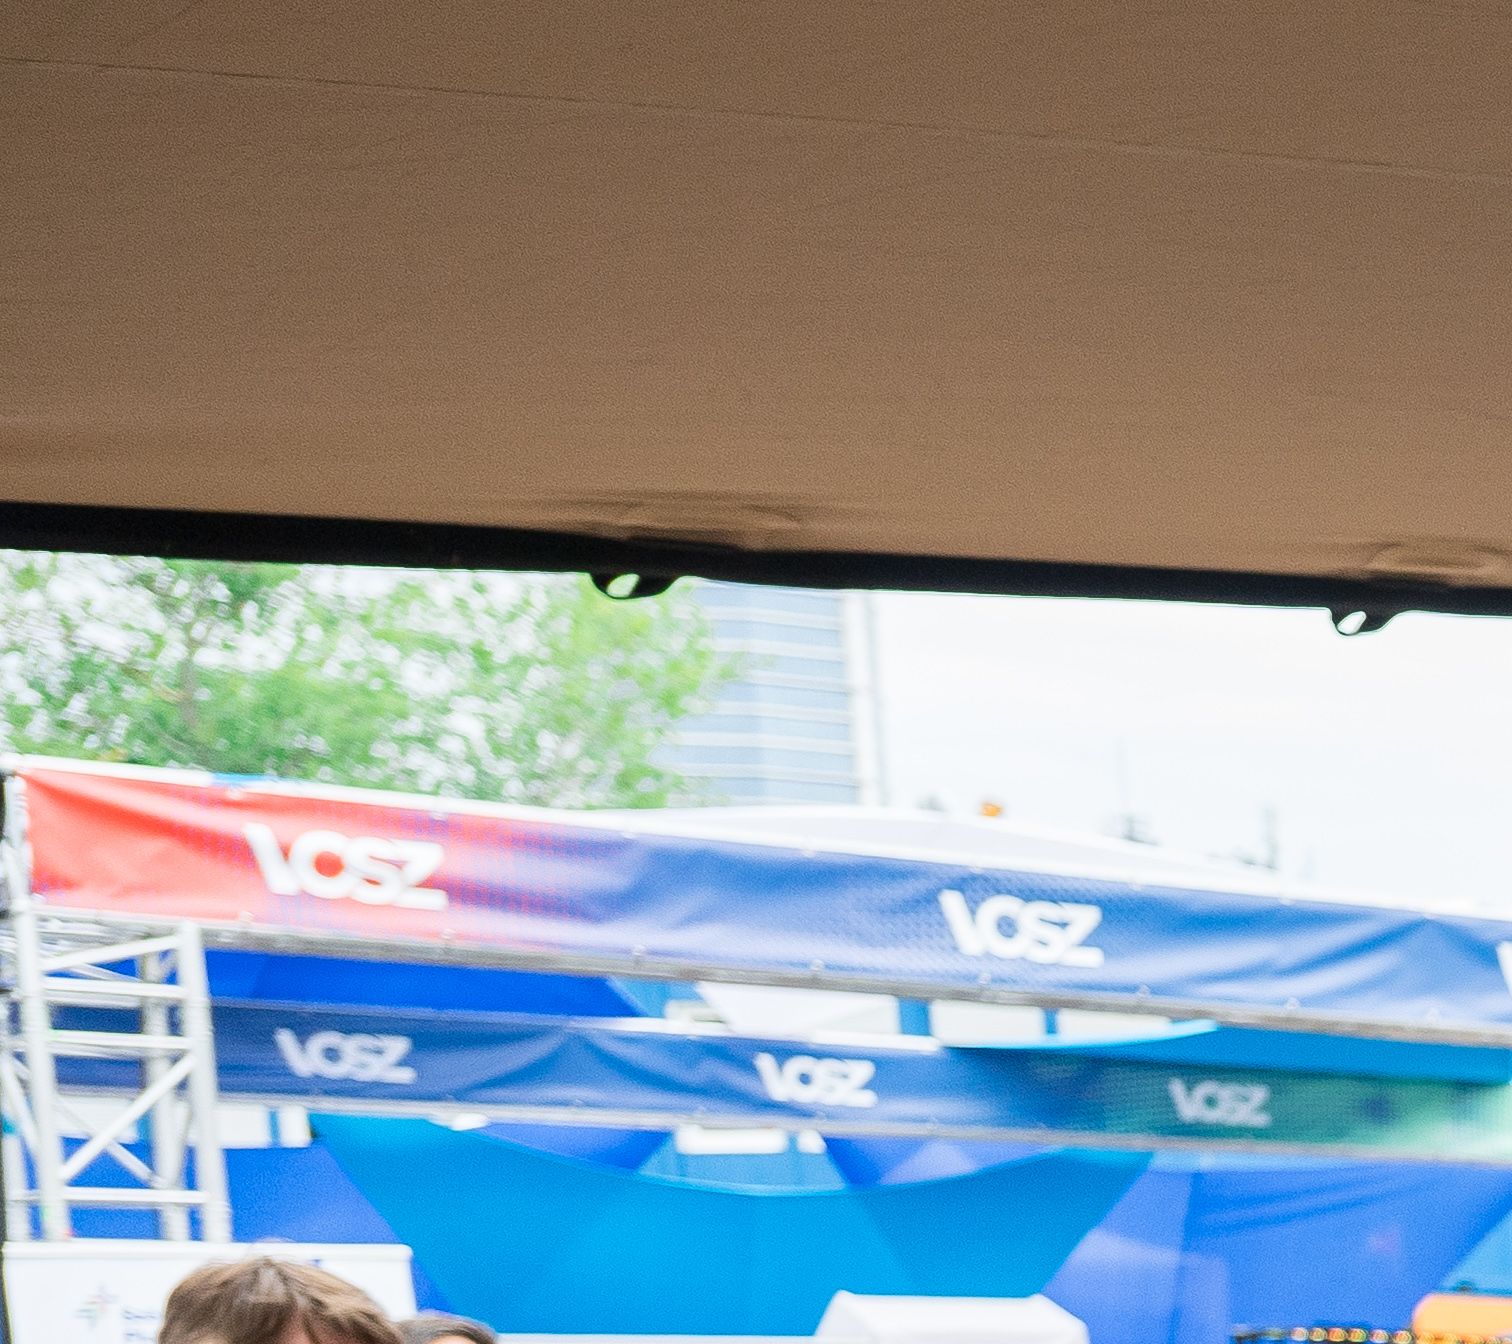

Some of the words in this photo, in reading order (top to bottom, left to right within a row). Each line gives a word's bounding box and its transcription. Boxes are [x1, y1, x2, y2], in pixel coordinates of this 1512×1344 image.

[245, 822, 448, 911] VOSZ
[938, 888, 1105, 969] VOSZ
[275, 1027, 417, 1084] VOSZ
[753, 1052, 879, 1108] VOSZ
[1168, 1077, 1270, 1128] VOSZ
